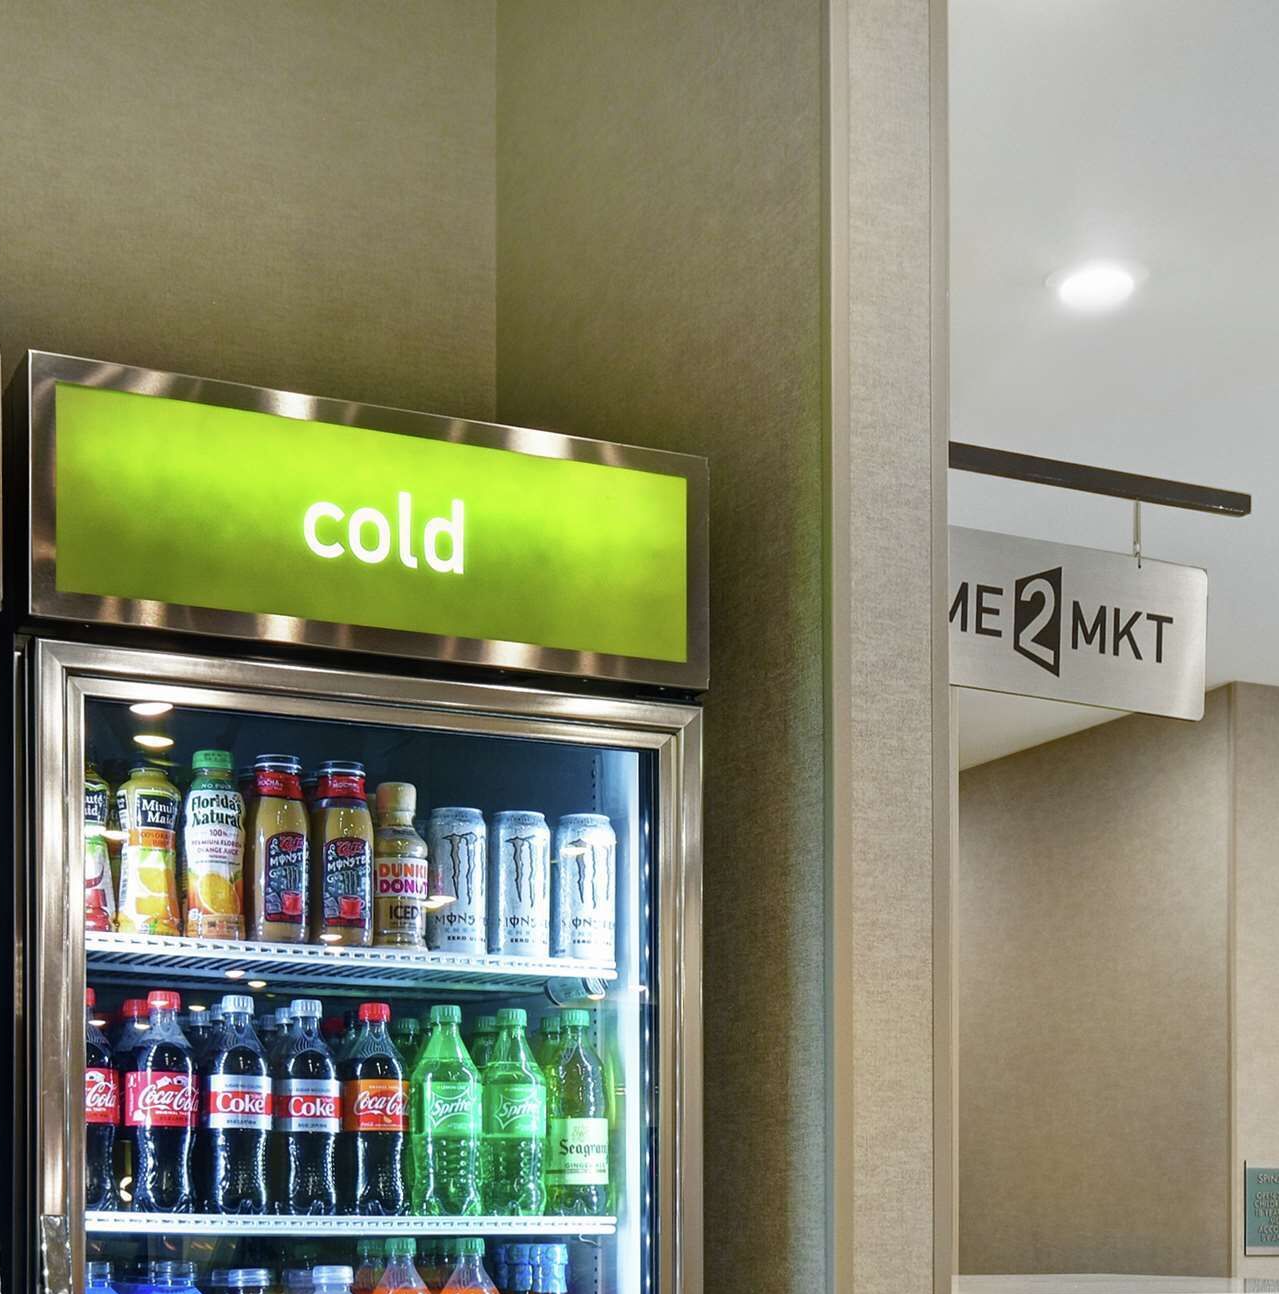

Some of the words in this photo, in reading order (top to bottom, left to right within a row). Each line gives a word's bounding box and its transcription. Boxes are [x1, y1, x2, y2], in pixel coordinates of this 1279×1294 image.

[302, 492, 465, 575] cold
[191, 795, 243, 814] Florida's
[191, 810, 241, 828] Natural
[389, 905, 420, 920] ICED
[215, 1092, 265, 1114] Coke
[289, 1097, 335, 1116] Coke
[431, 1097, 476, 1119] Sprite
[499, 1099, 541, 1117] Sprite
